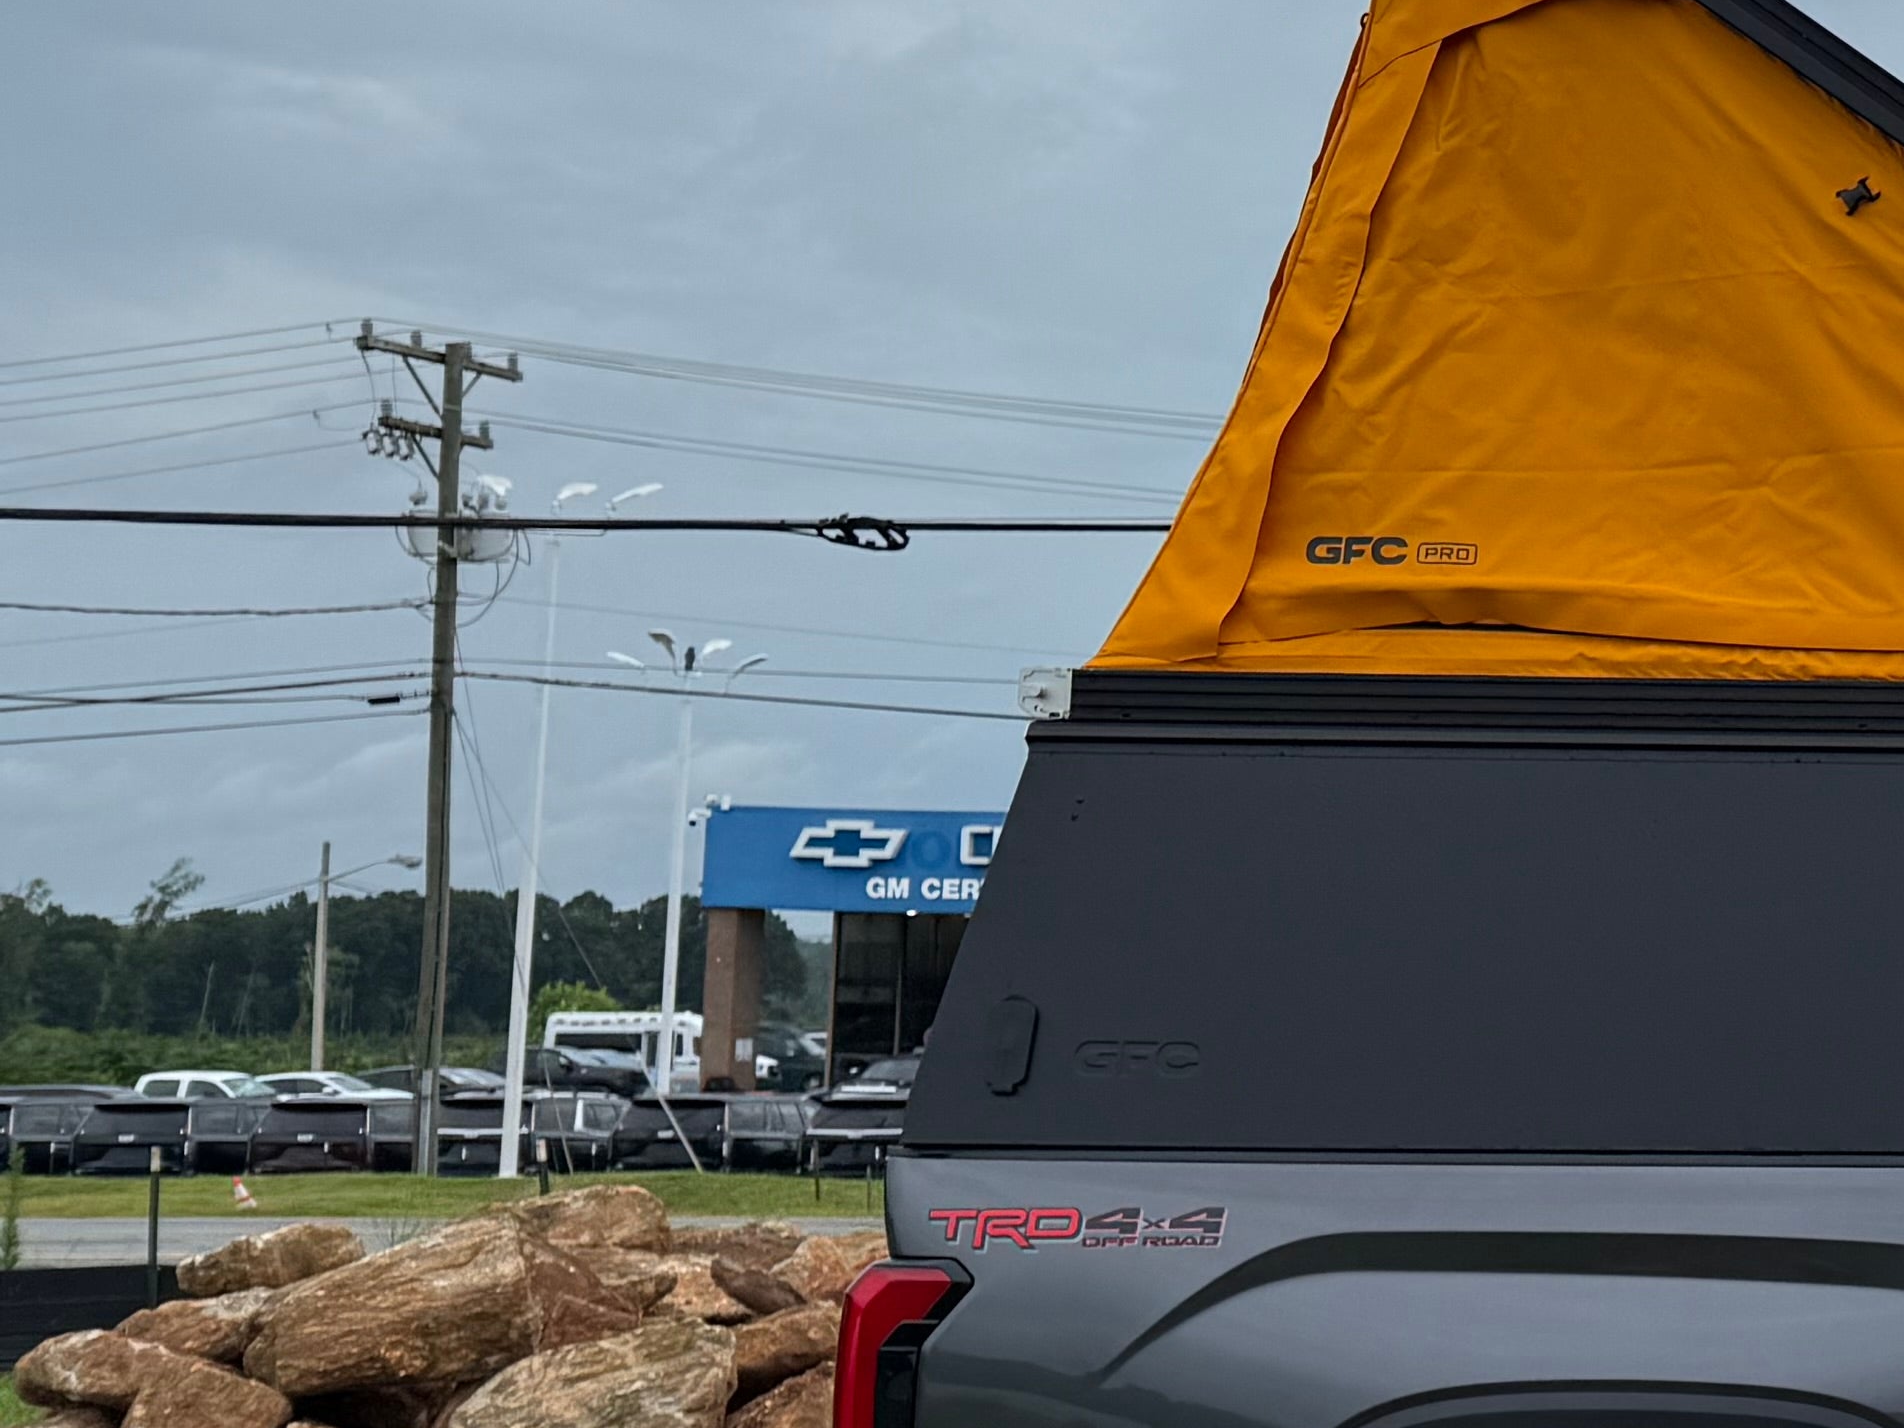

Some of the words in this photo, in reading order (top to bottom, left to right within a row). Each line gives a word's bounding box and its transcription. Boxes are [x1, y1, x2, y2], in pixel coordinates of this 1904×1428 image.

[1305, 535, 1409, 566] GFC
[1424, 546, 1471, 562] PRO
[866, 876, 910, 900] GM
[921, 877, 985, 900] CER
[1073, 1039, 1201, 1076] GFC
[928, 1207, 1086, 1253] TRD
[1081, 1235, 1139, 1248] OFF
[1141, 1235, 1221, 1247] ROAD
